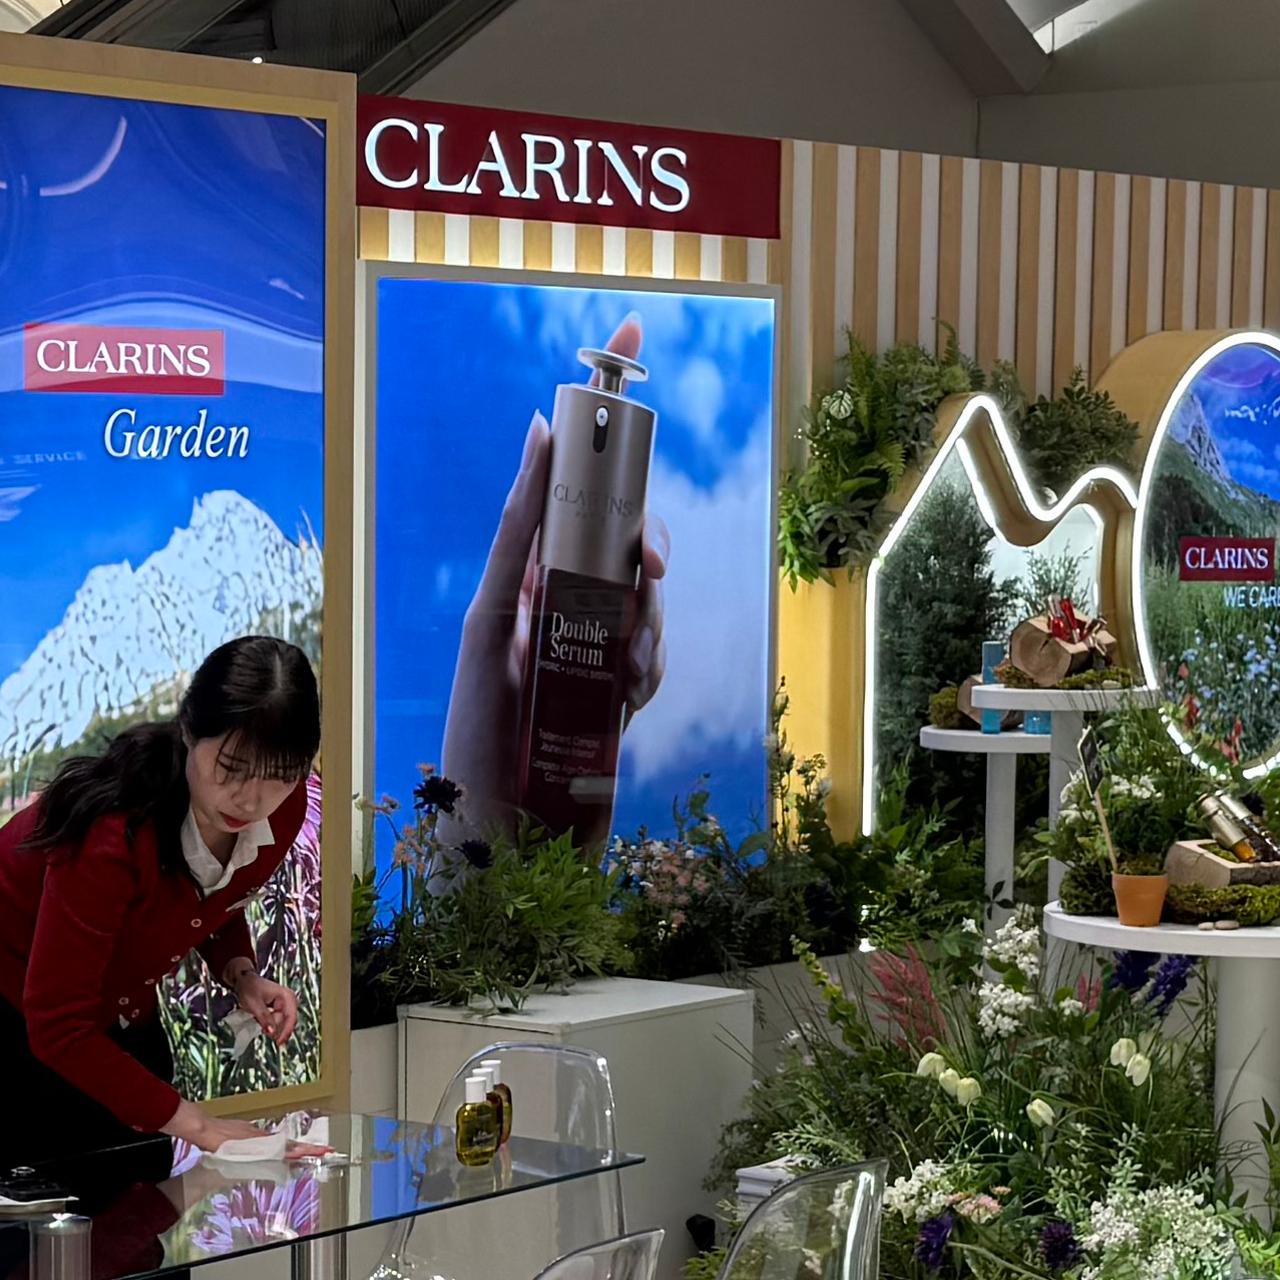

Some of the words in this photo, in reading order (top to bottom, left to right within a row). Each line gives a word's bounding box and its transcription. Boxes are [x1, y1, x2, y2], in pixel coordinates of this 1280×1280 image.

[364, 117, 691, 213] CLARINS
[36, 339, 211, 377] CLARINS
[104, 408, 250, 458] Garden
[1185, 547, 1269, 569] CLARINS
[1223, 586, 1247, 608] WE
[551, 612, 608, 645] Double
[550, 635, 603, 667] Serum
